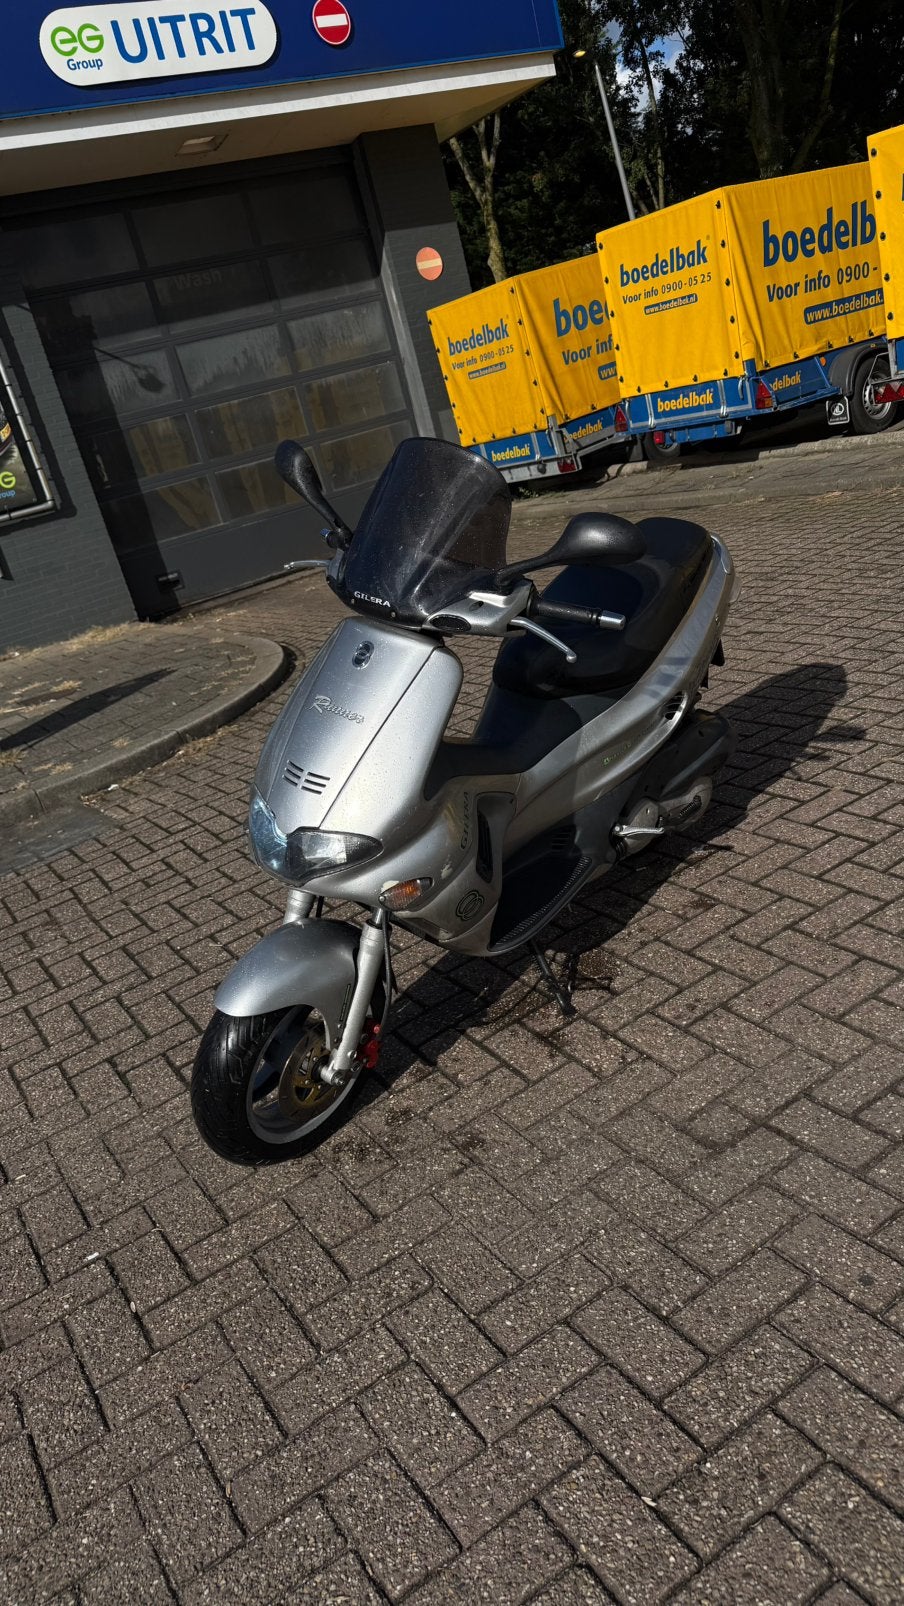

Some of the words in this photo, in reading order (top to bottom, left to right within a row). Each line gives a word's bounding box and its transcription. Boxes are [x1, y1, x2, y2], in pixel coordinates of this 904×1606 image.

[110, 7, 256, 64] UITRIT
[66, 57, 104, 71] Group
[620, 239, 708, 287] boedelbak
[622, 292, 641, 304] Voor
[644, 287, 659, 299] info
[766, 281, 800, 302] Voor
[804, 269, 831, 293] info
[645, 294, 696, 315] www.boedelbak.nl
[448, 318, 509, 356] boedelbak
[452, 360, 465, 370] Voor
[465, 357, 478, 367] info
[562, 345, 592, 365] Voor
[657, 389, 714, 413] boedelbak
[491, 445, 531, 462] boedelbak
[353, 591, 391, 607] GILERA
[309, 694, 365, 724] Runner
